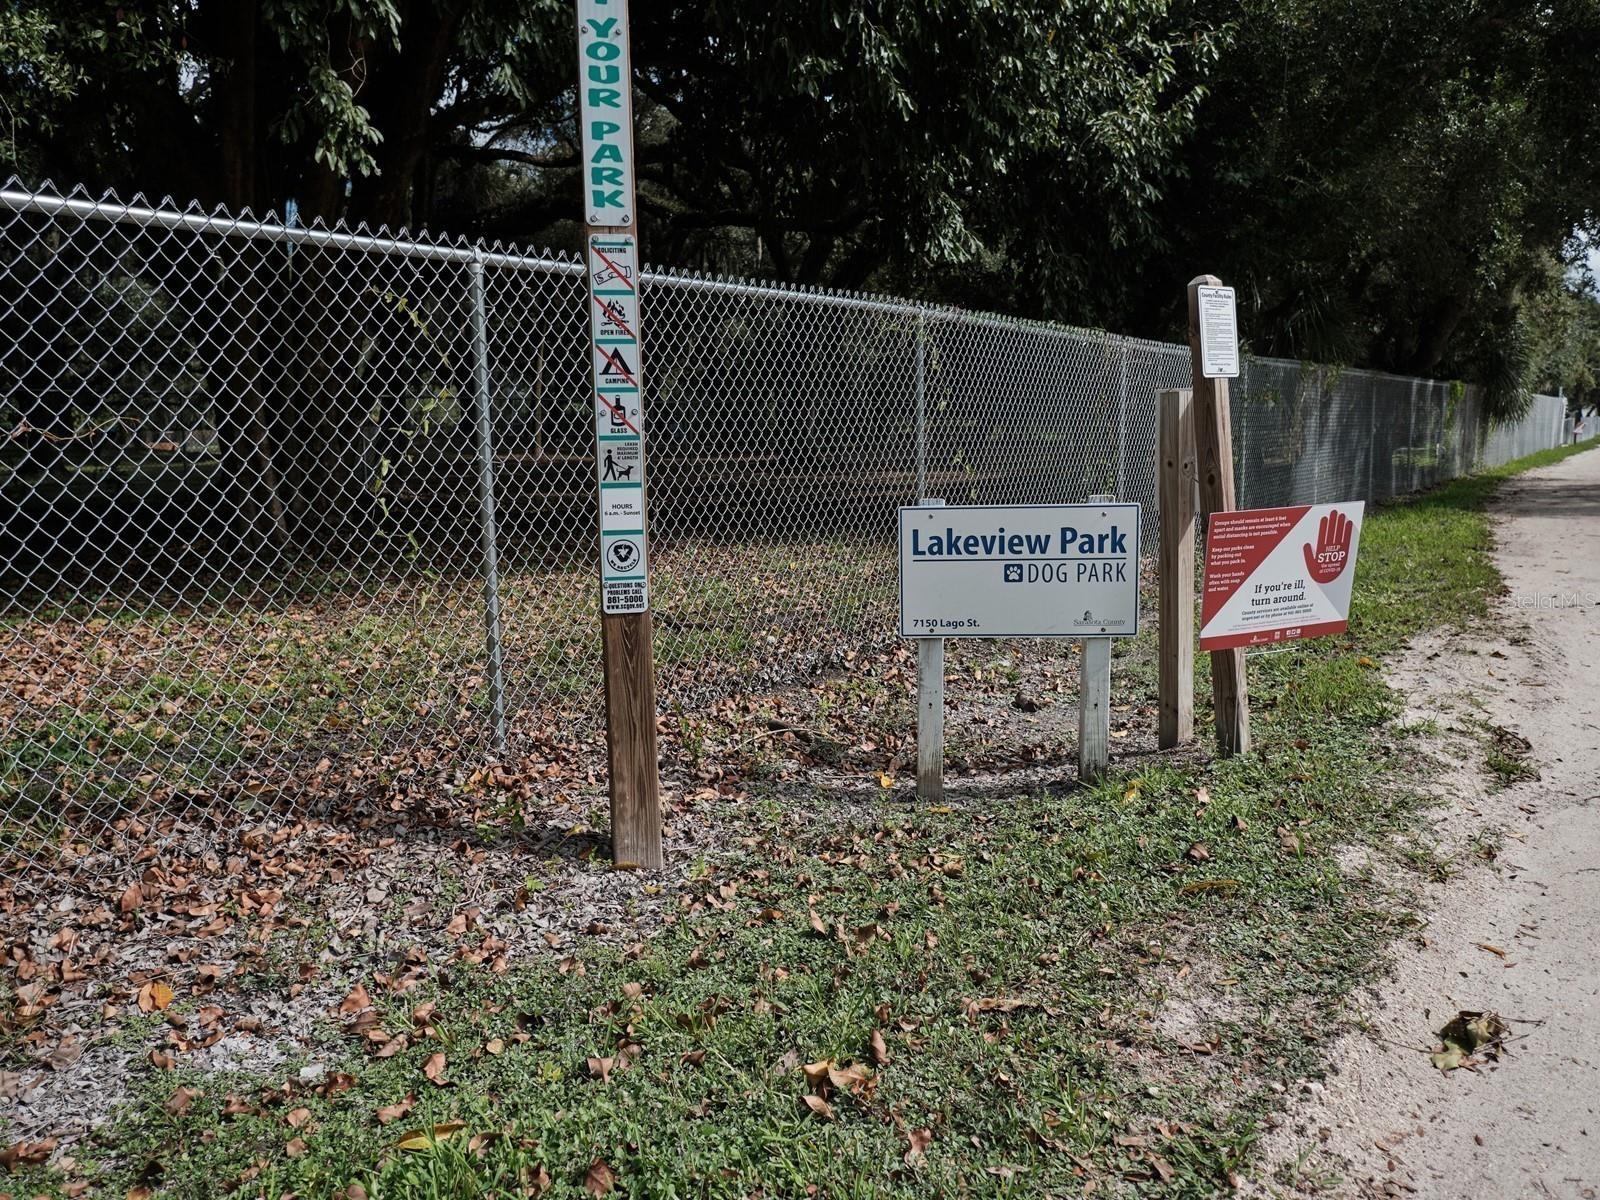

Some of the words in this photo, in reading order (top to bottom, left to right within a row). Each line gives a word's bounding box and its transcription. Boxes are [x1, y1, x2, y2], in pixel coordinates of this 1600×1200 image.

[586, 17, 621, 108] YOUR
[591, 121, 625, 208] PARK
[912, 527, 1051, 556] Lakeview
[1060, 525, 1127, 554] Park
[1318, 551, 1346, 563] STOP
[1028, 563, 1068, 583] DOG
[1077, 562, 1126, 583] PARK
[1254, 584, 1263, 594] If
[1264, 582, 1292, 595] you're
[1294, 580, 1306, 590] ill,
[607, 595, 643, 604] 861-5000
[1251, 597, 1271, 606] turn
[1273, 592, 1306, 604] around.
[913, 619, 938, 627] 7150
[940, 618, 964, 629] Lago
[967, 618, 980, 627] St.
